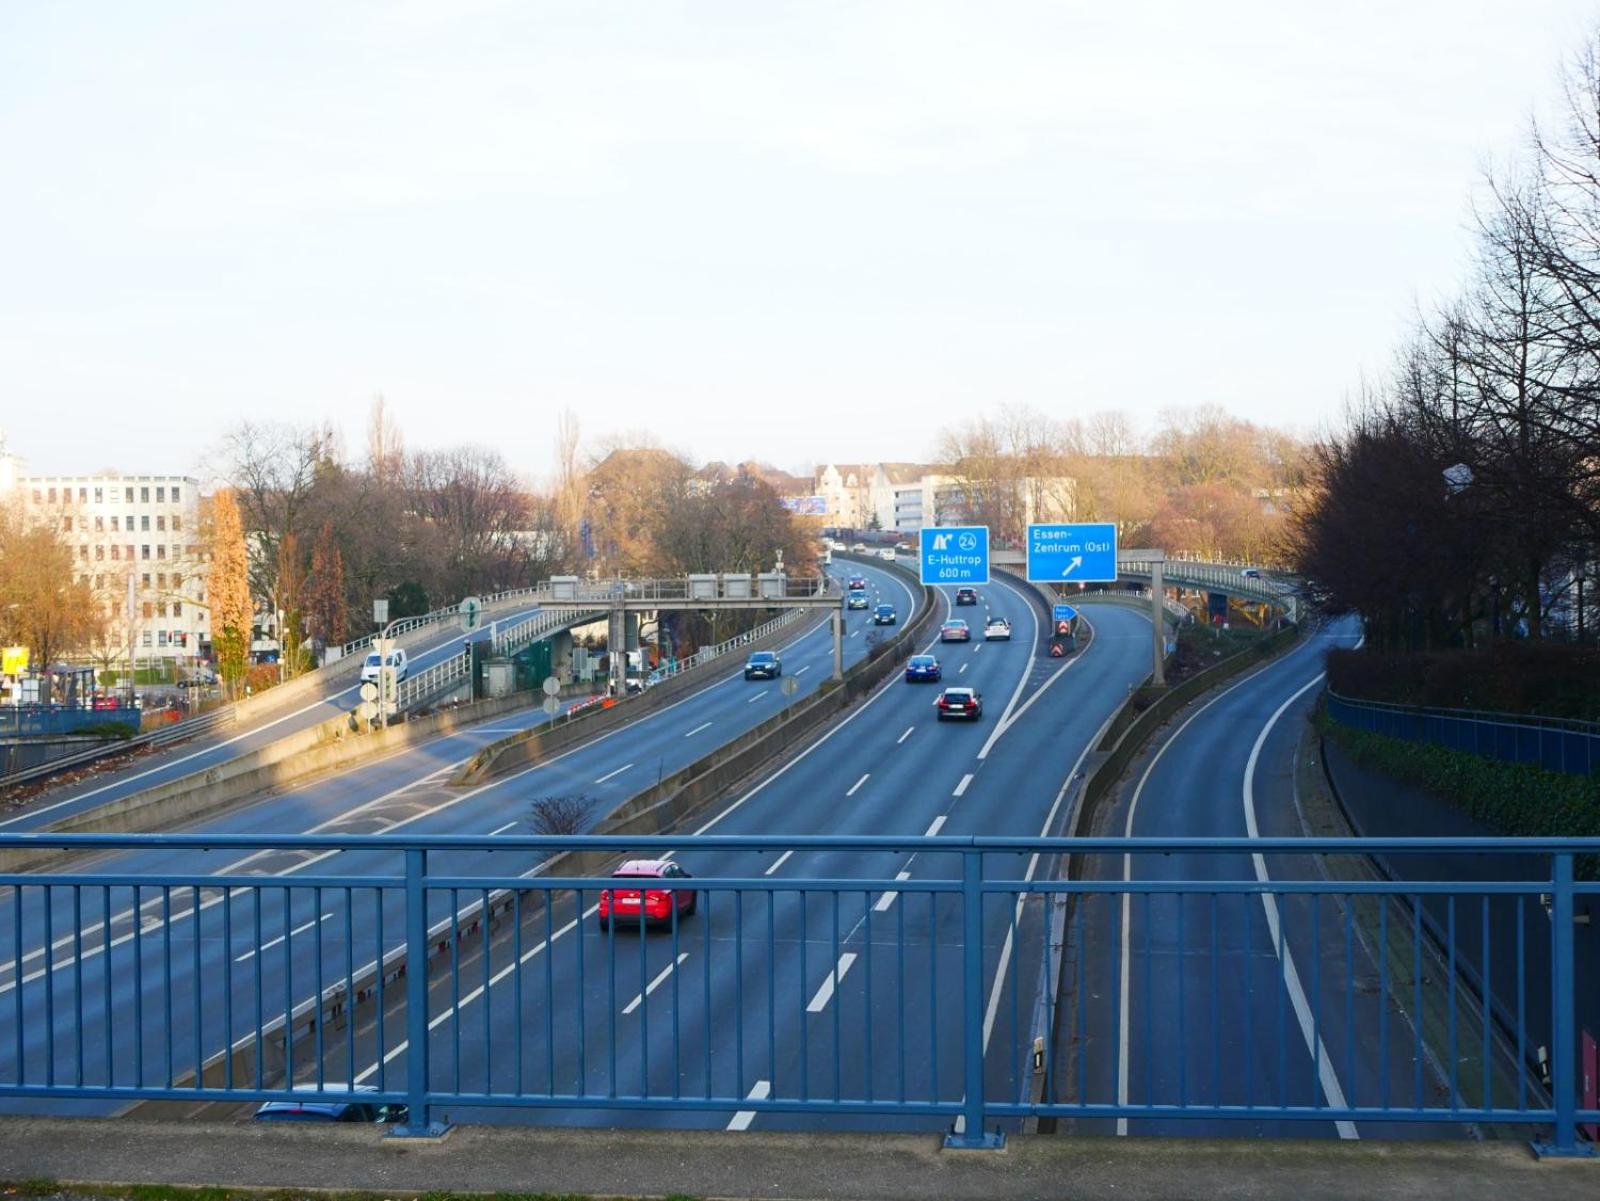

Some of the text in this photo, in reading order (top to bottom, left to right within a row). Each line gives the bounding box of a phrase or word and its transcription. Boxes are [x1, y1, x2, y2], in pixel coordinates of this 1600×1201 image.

[1033, 529, 1072, 539] Essen-
[1034, 541, 1110, 553] Zentrum (Ost)
[928, 555, 982, 566] E-Huttrop
[939, 568, 971, 578] 600 m
